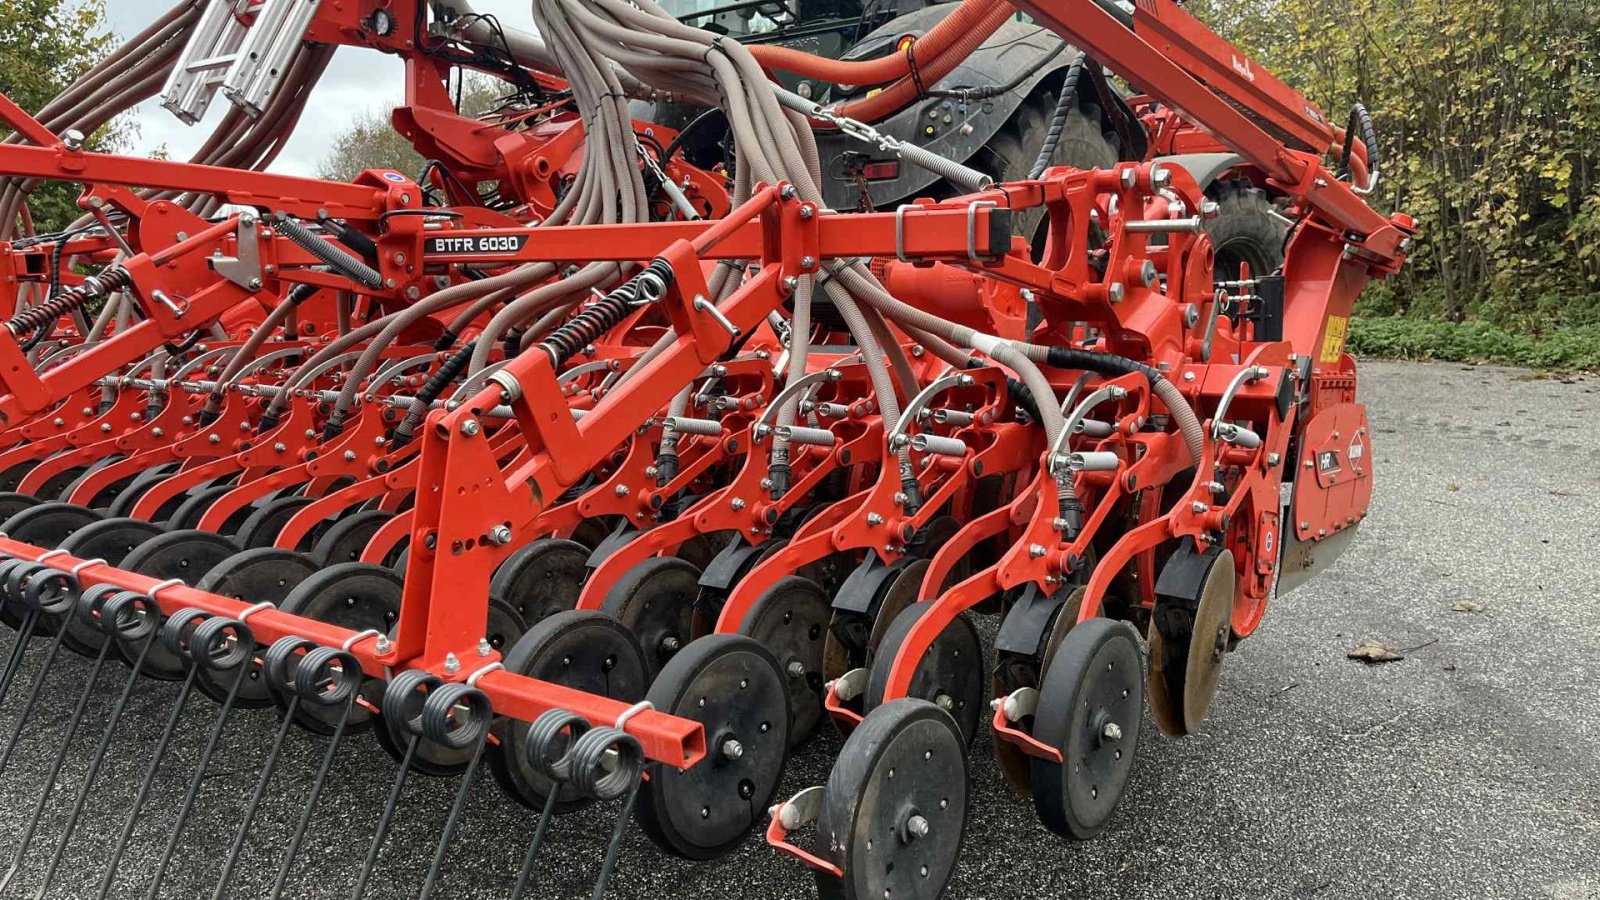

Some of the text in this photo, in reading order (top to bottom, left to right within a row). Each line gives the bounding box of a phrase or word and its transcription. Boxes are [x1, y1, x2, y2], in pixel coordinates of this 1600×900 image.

[435, 237, 519, 252] BTFR 6030
[1320, 453, 1331, 470] HR
